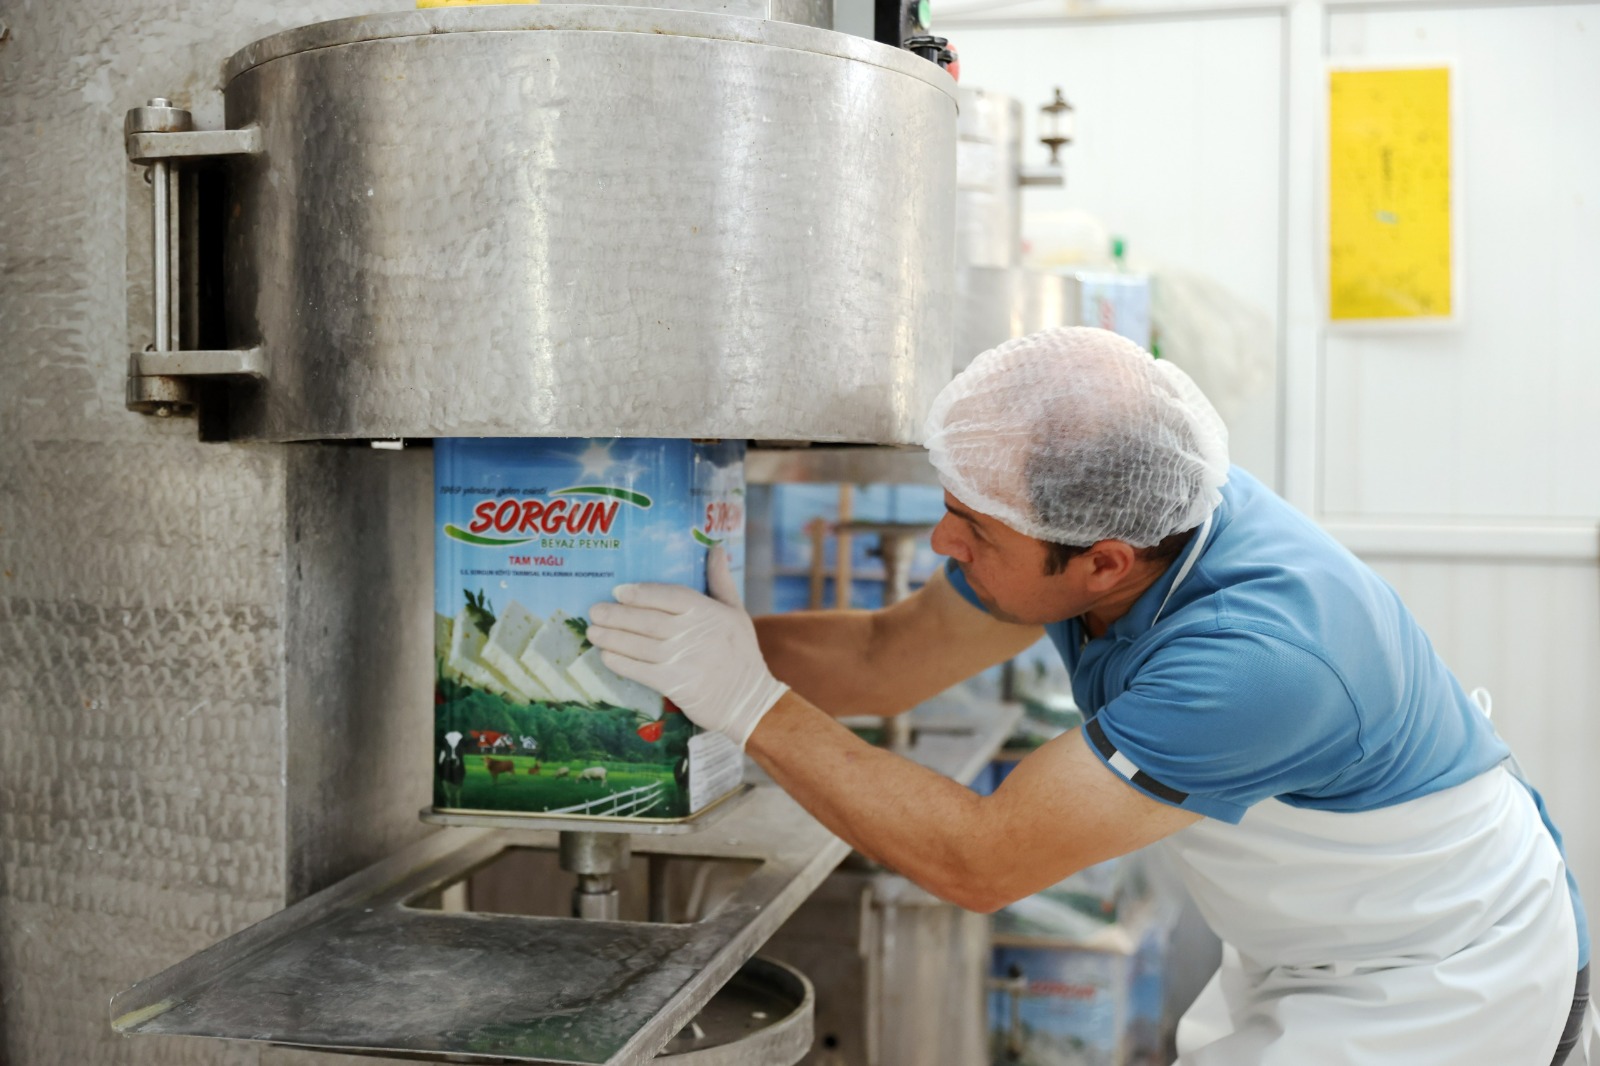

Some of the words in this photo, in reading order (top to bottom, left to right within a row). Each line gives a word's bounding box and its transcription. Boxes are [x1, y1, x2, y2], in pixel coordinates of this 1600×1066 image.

[469, 499, 620, 535] SORGUN
[541, 539, 575, 549] BEYAZ
[509, 555, 531, 566] TAM
[533, 554, 564, 566] YAĞLI
